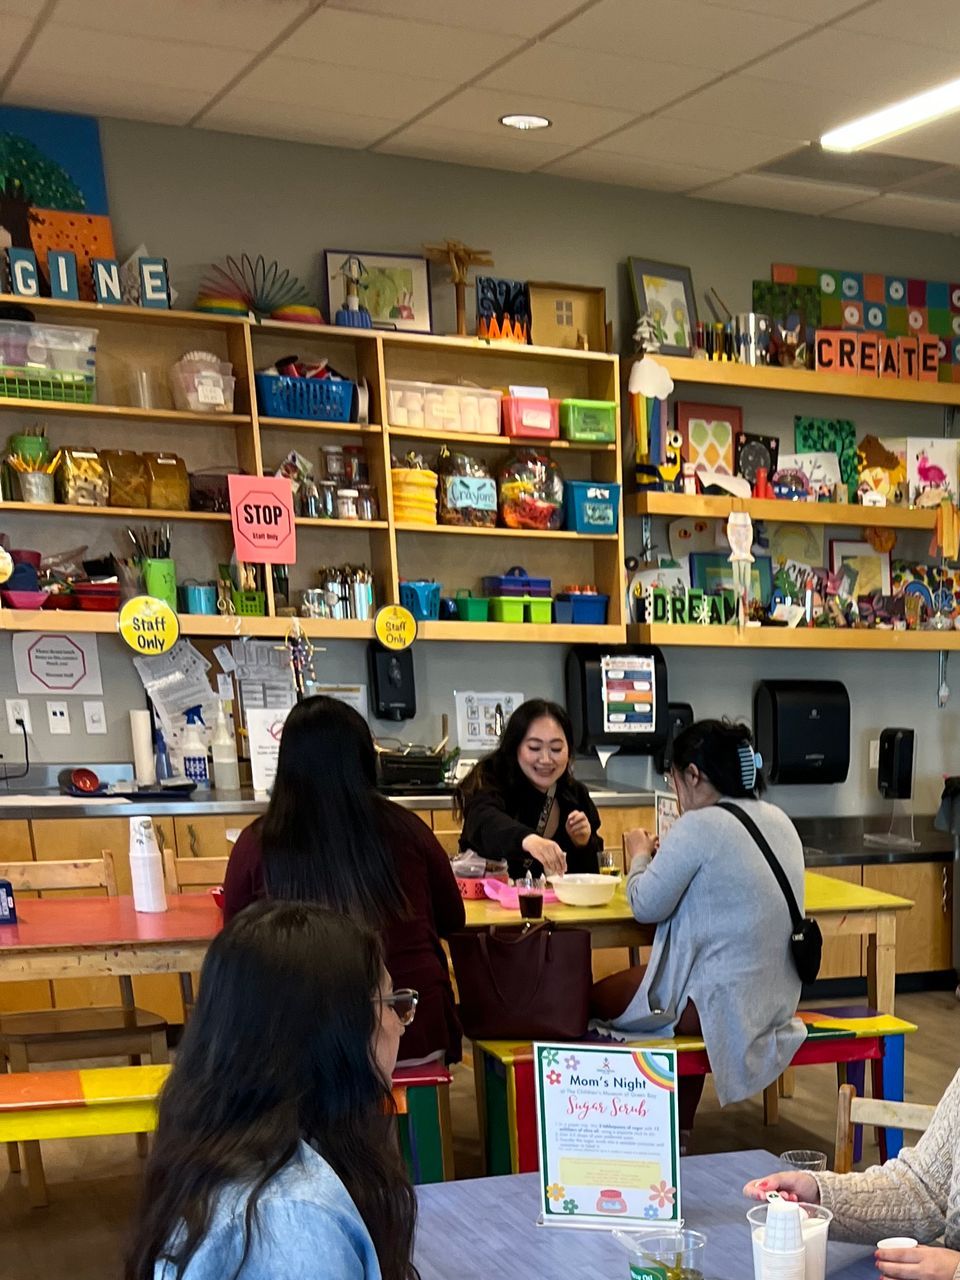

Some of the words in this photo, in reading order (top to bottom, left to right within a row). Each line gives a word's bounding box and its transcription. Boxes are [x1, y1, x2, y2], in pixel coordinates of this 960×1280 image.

[817, 337, 939, 377] CREATE
[243, 503, 283, 525] STOP
[132, 616, 167, 632] Staff
[385, 620, 407, 632] Staff
[137, 635, 166, 652] Only
[386, 633, 406, 646] Only
[570, 1074, 609, 1087] Mom's
[613, 1077, 646, 1092] Night
[566, 1094, 607, 1120] Sugar
[609, 1096, 649, 1117] Scrub
